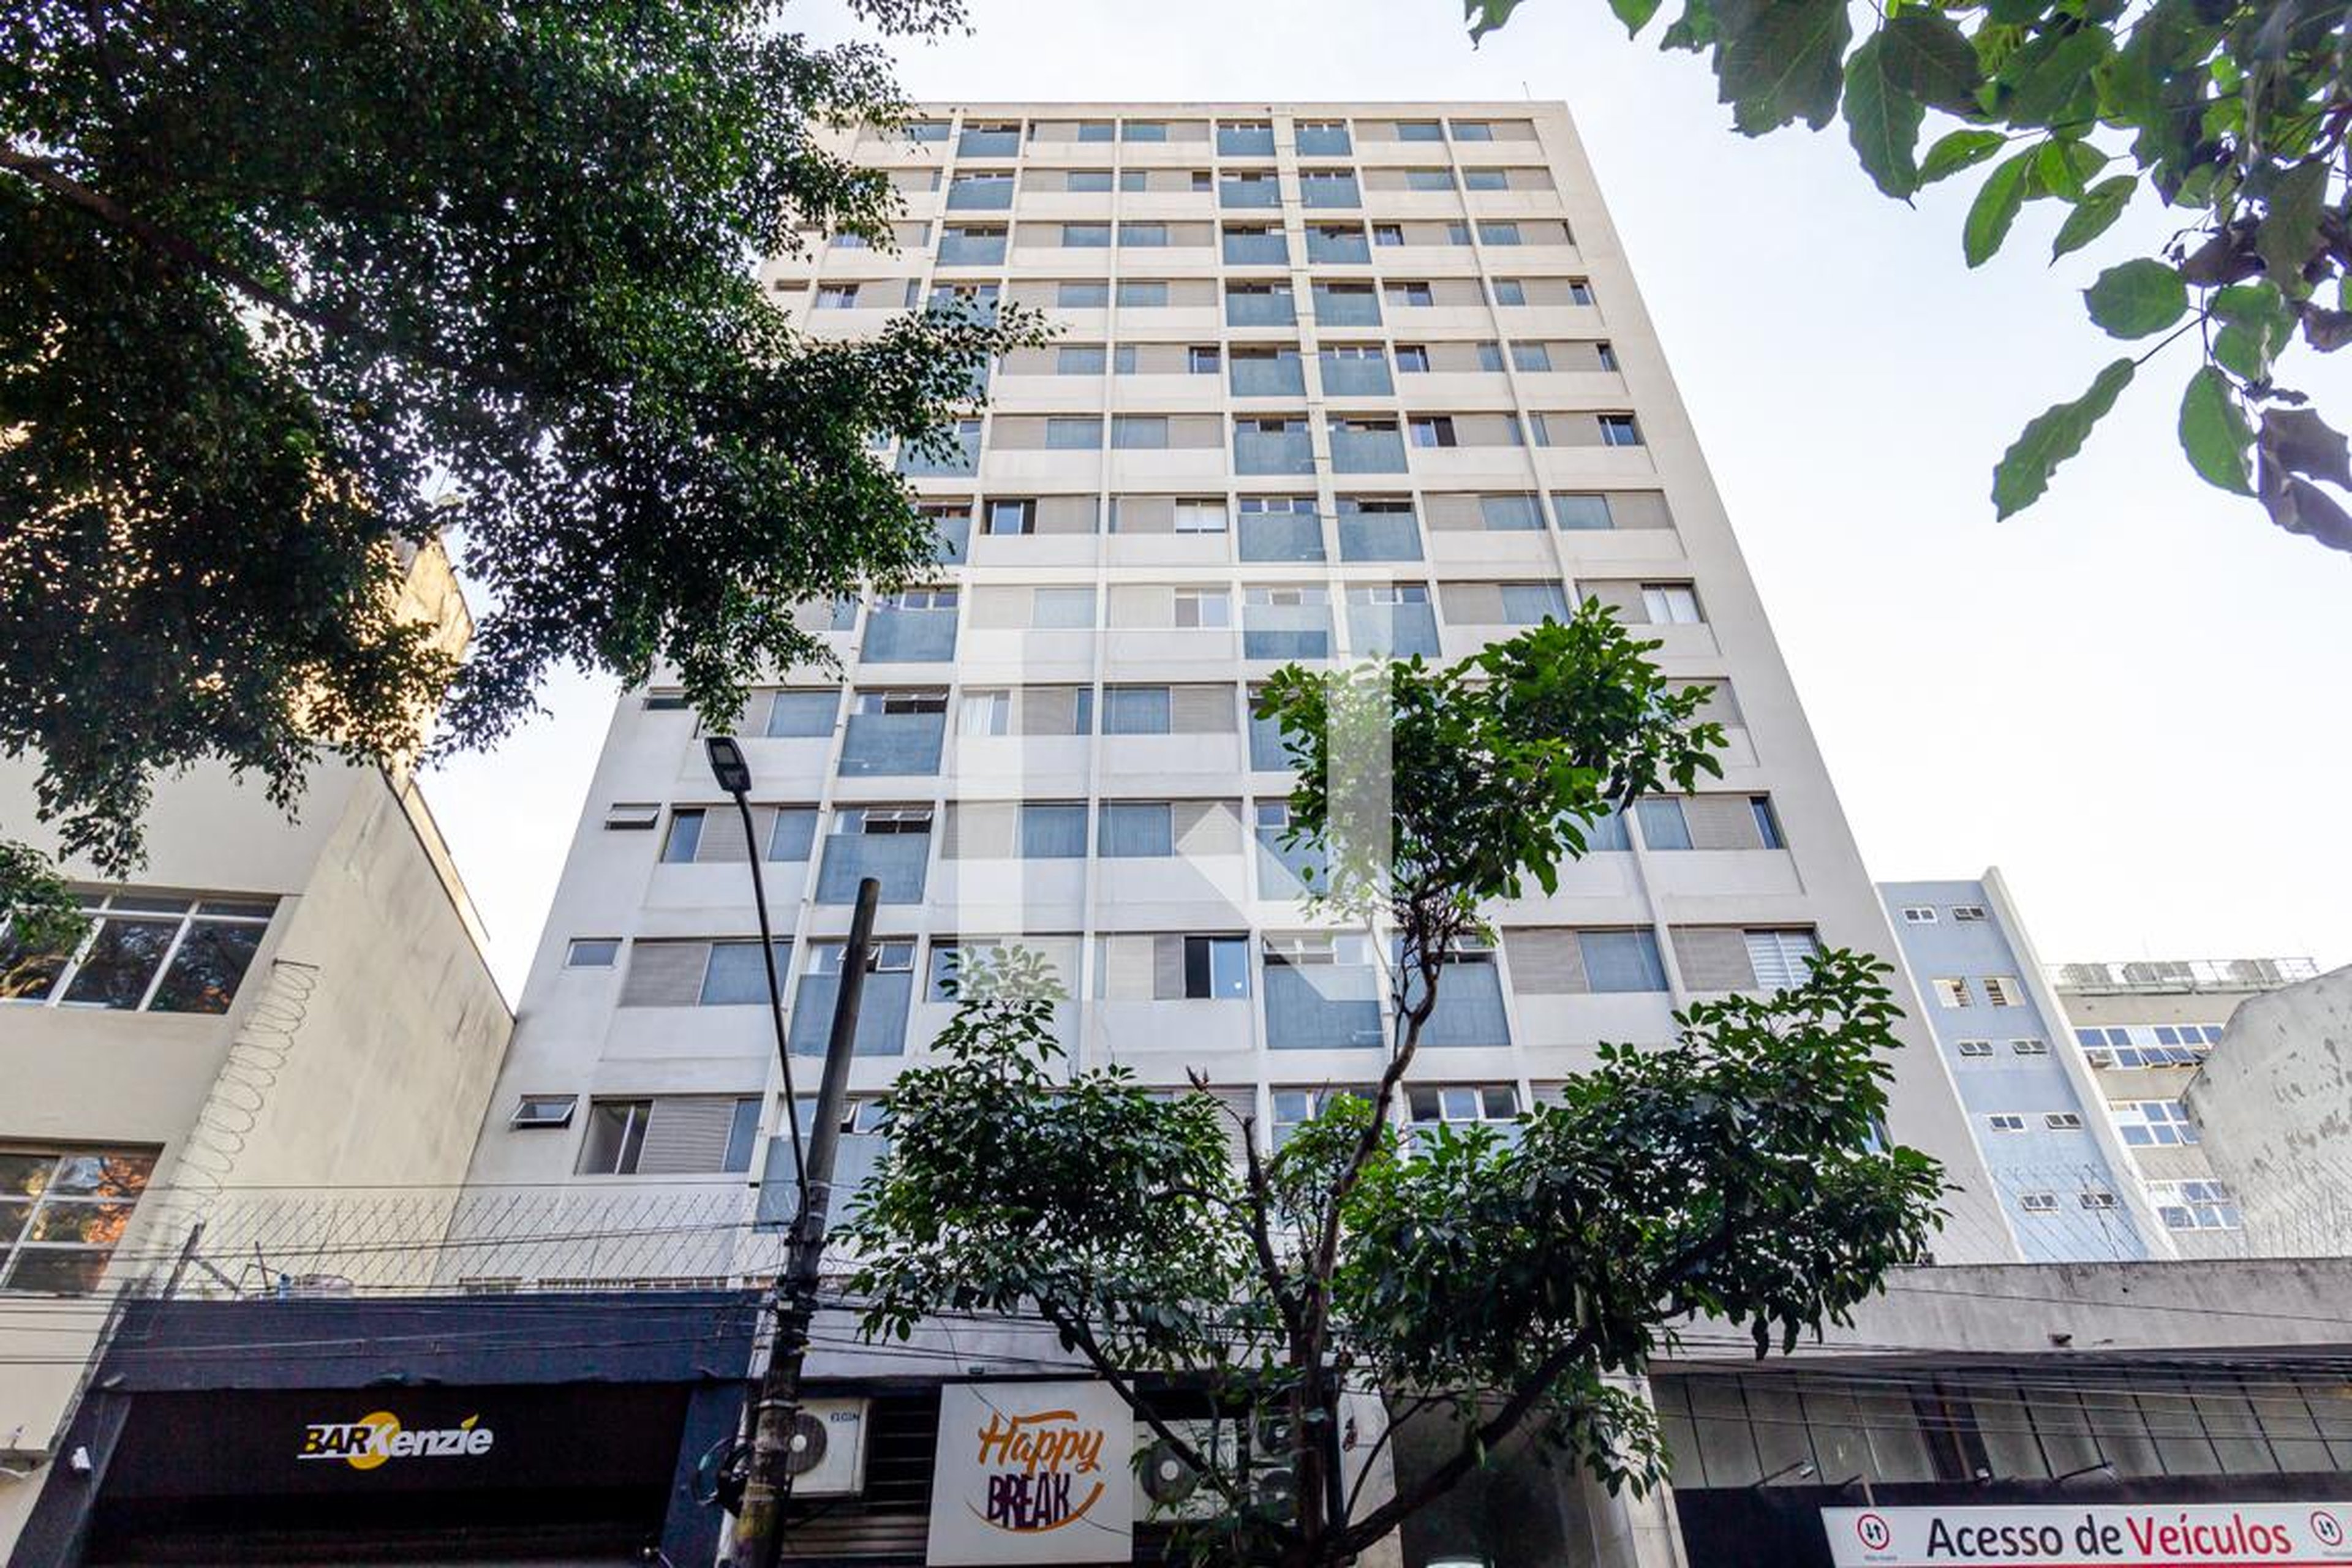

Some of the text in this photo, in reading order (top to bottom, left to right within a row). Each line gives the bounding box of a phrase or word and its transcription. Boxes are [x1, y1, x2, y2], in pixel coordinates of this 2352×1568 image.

[978, 1411, 1103, 1477] Happy
[987, 1472, 1071, 1528] BREAK
[1926, 1513, 2292, 1558] Acesso de Veículos
